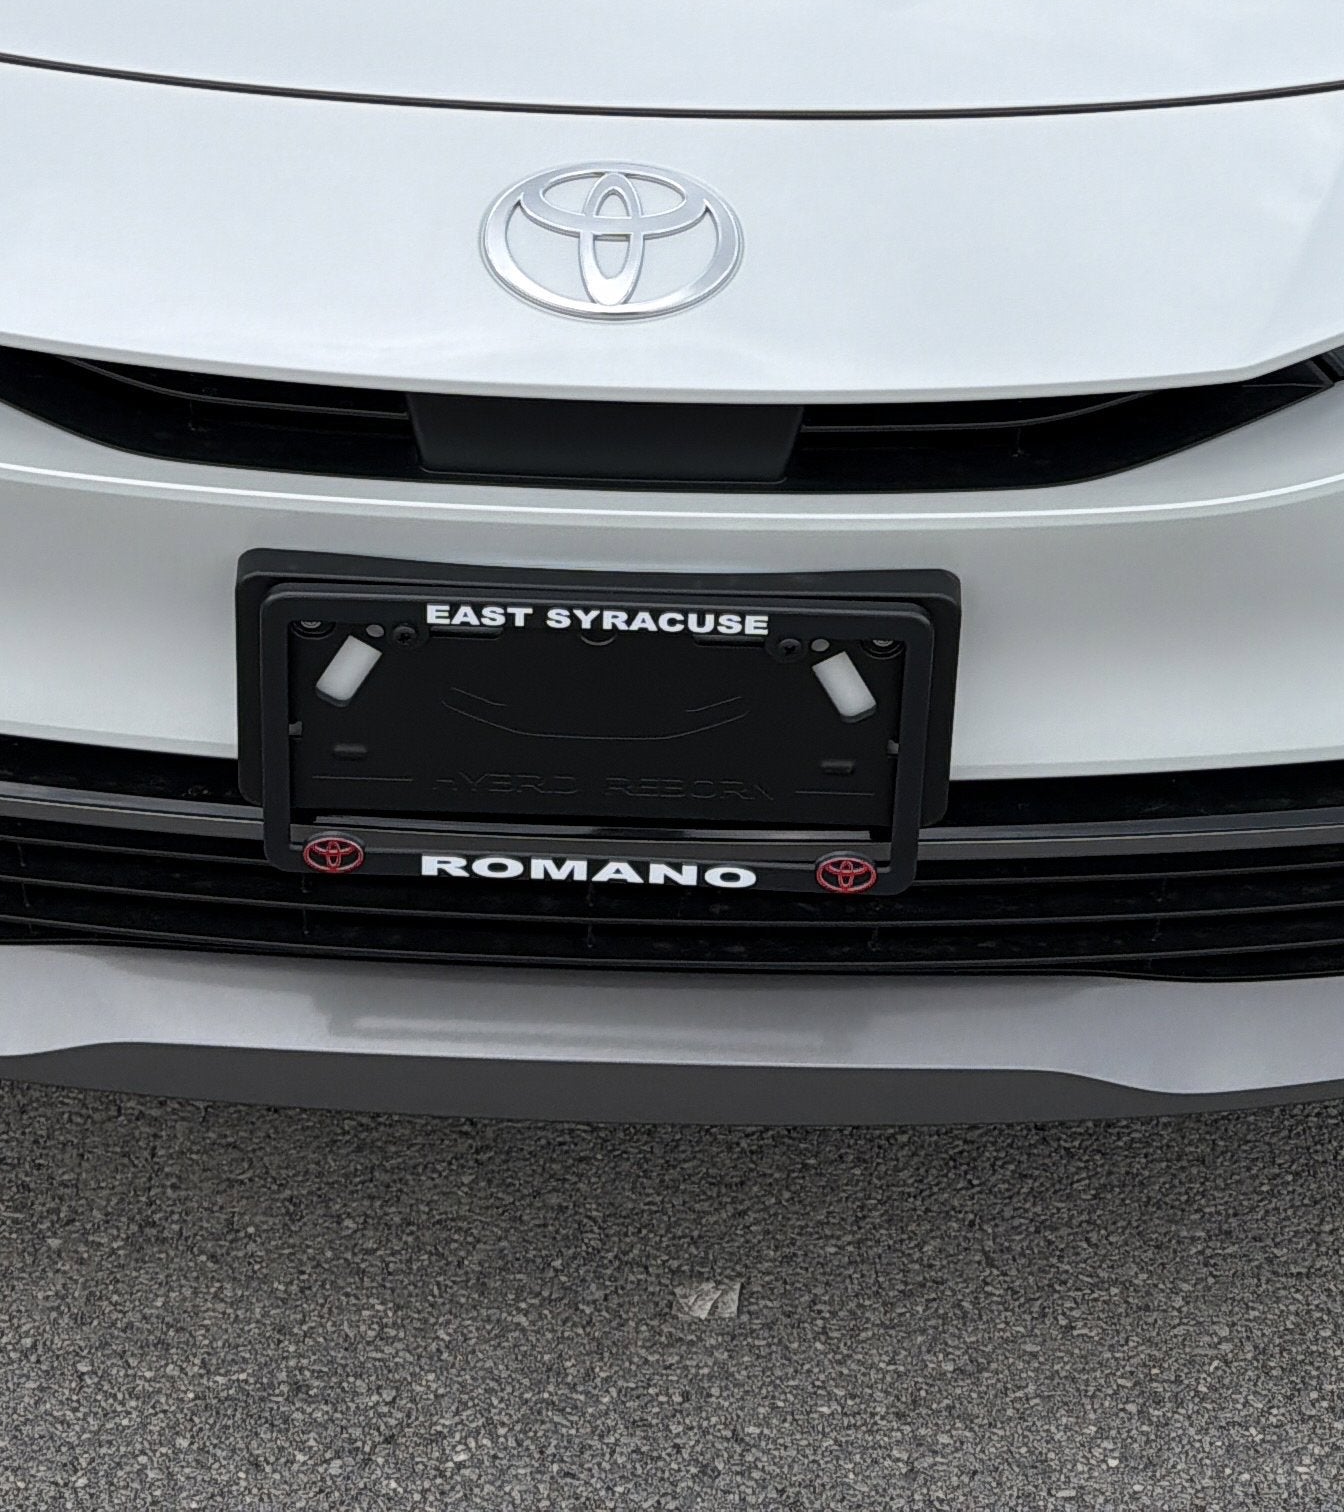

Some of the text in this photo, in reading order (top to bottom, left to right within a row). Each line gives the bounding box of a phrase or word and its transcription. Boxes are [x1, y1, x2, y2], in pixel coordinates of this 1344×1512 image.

[426, 604, 769, 636] EAST SYRACUSE
[421, 854, 757, 888] ROMANO
